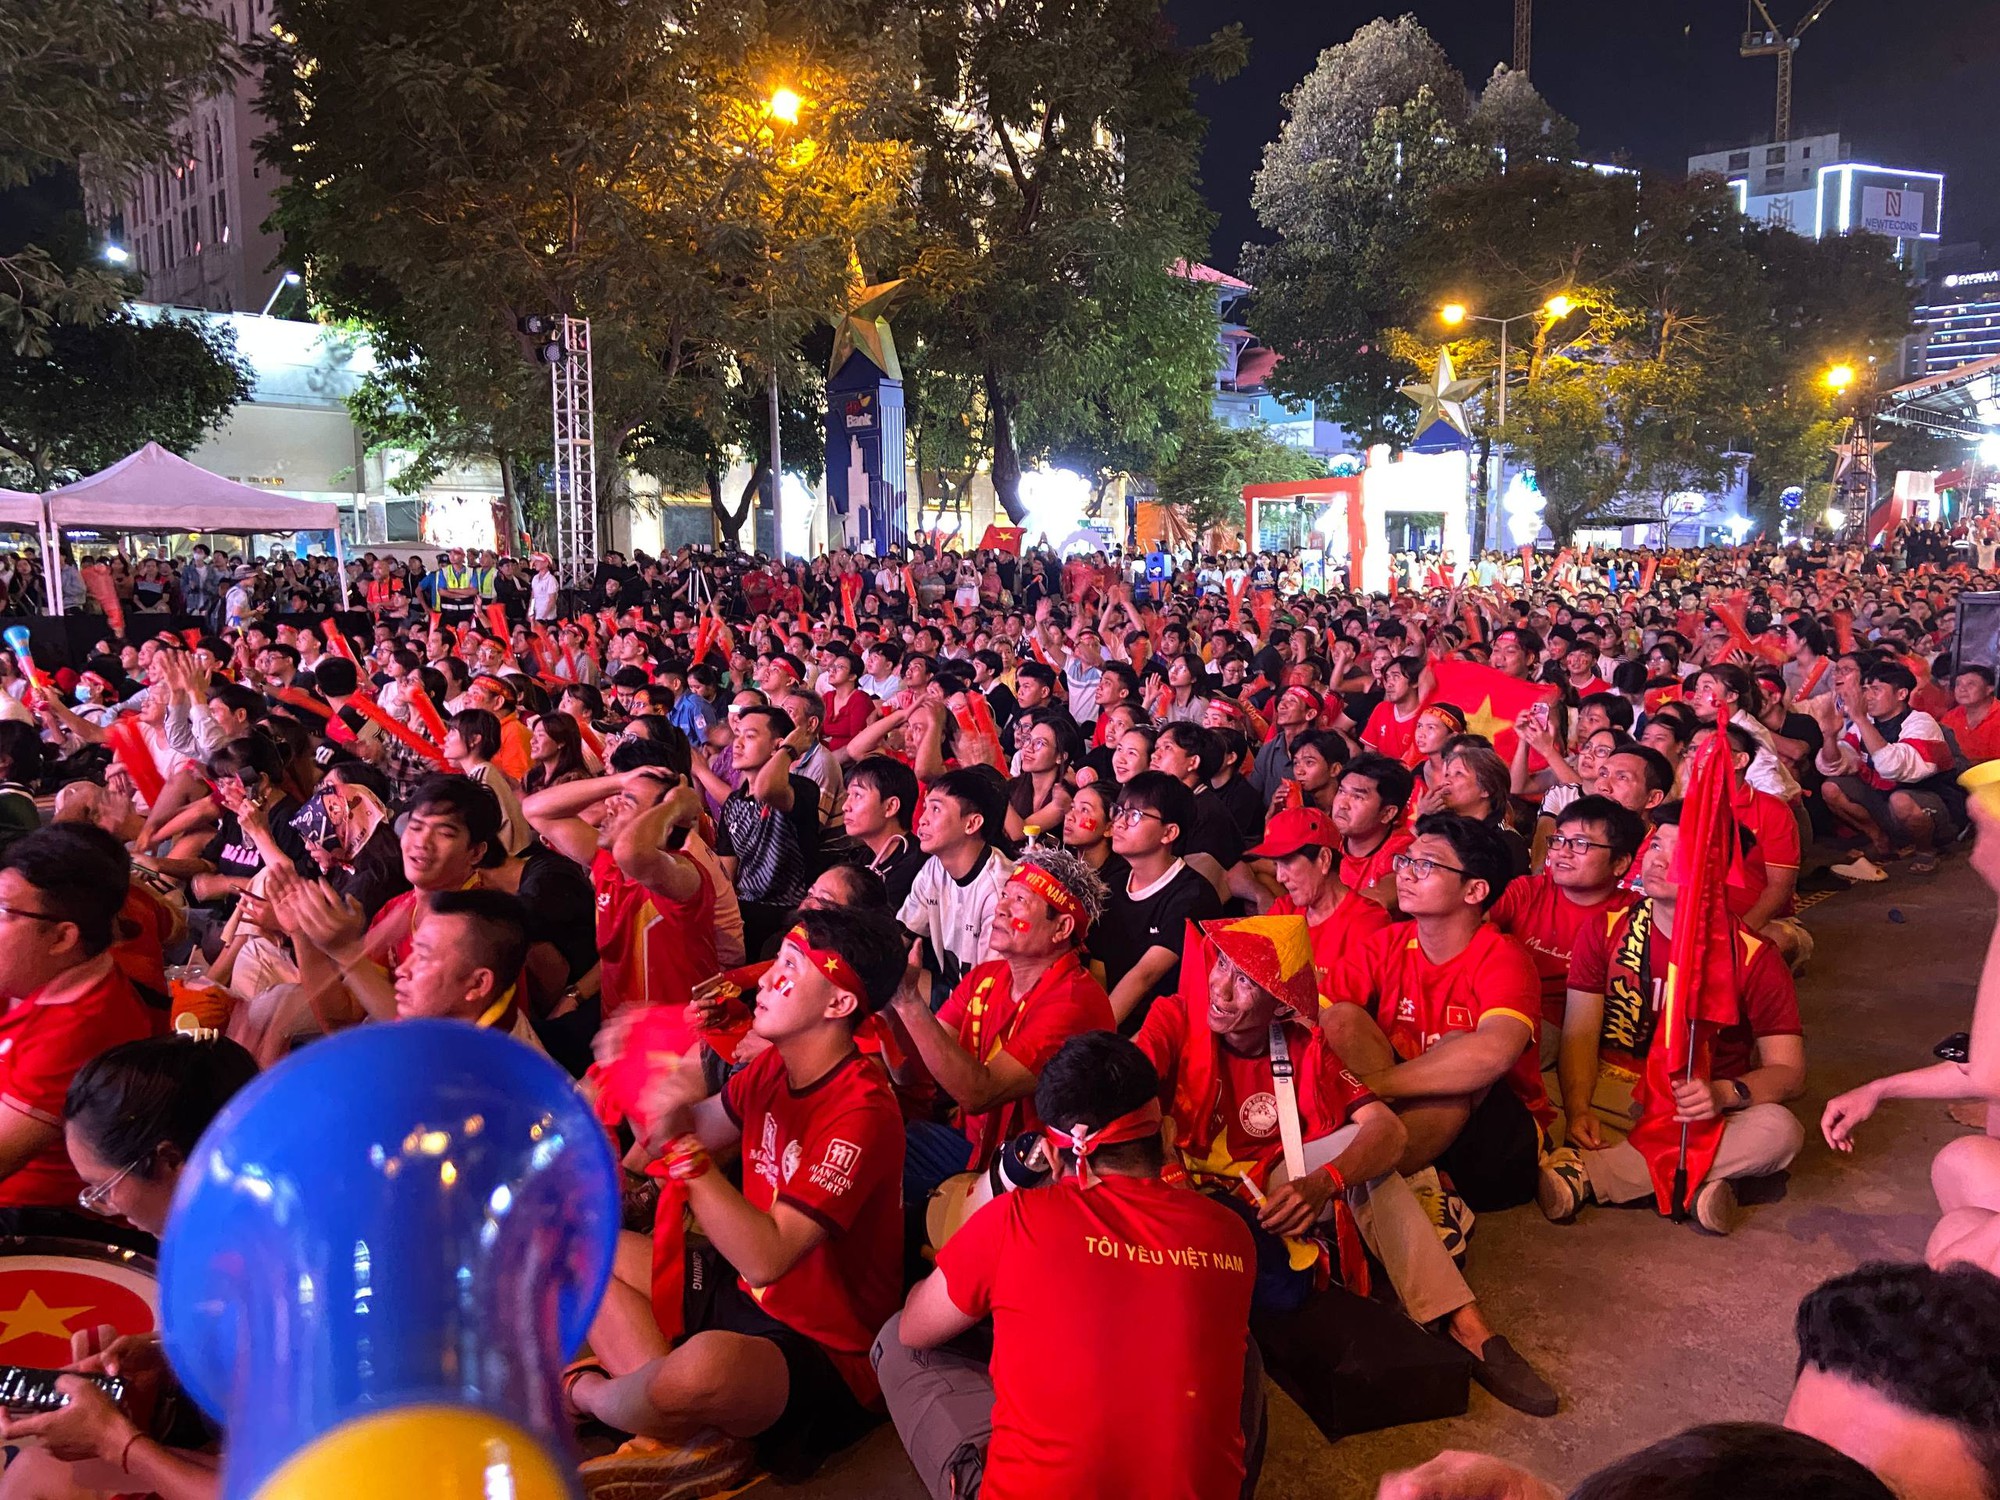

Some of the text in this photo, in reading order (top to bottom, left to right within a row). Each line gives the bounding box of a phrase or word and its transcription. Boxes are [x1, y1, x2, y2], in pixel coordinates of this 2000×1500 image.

[1865, 217, 1918, 231] NEWTECONS
[846, 413, 872, 428] Bank
[1045, 883, 1068, 906] NAM
[1604, 979, 1643, 1048] STAR
[808, 1164, 853, 1190] MANSION
[809, 1173, 844, 1196] SPORTS
[1085, 1235, 1244, 1273] TÔI YÊU VIỆT NAM
